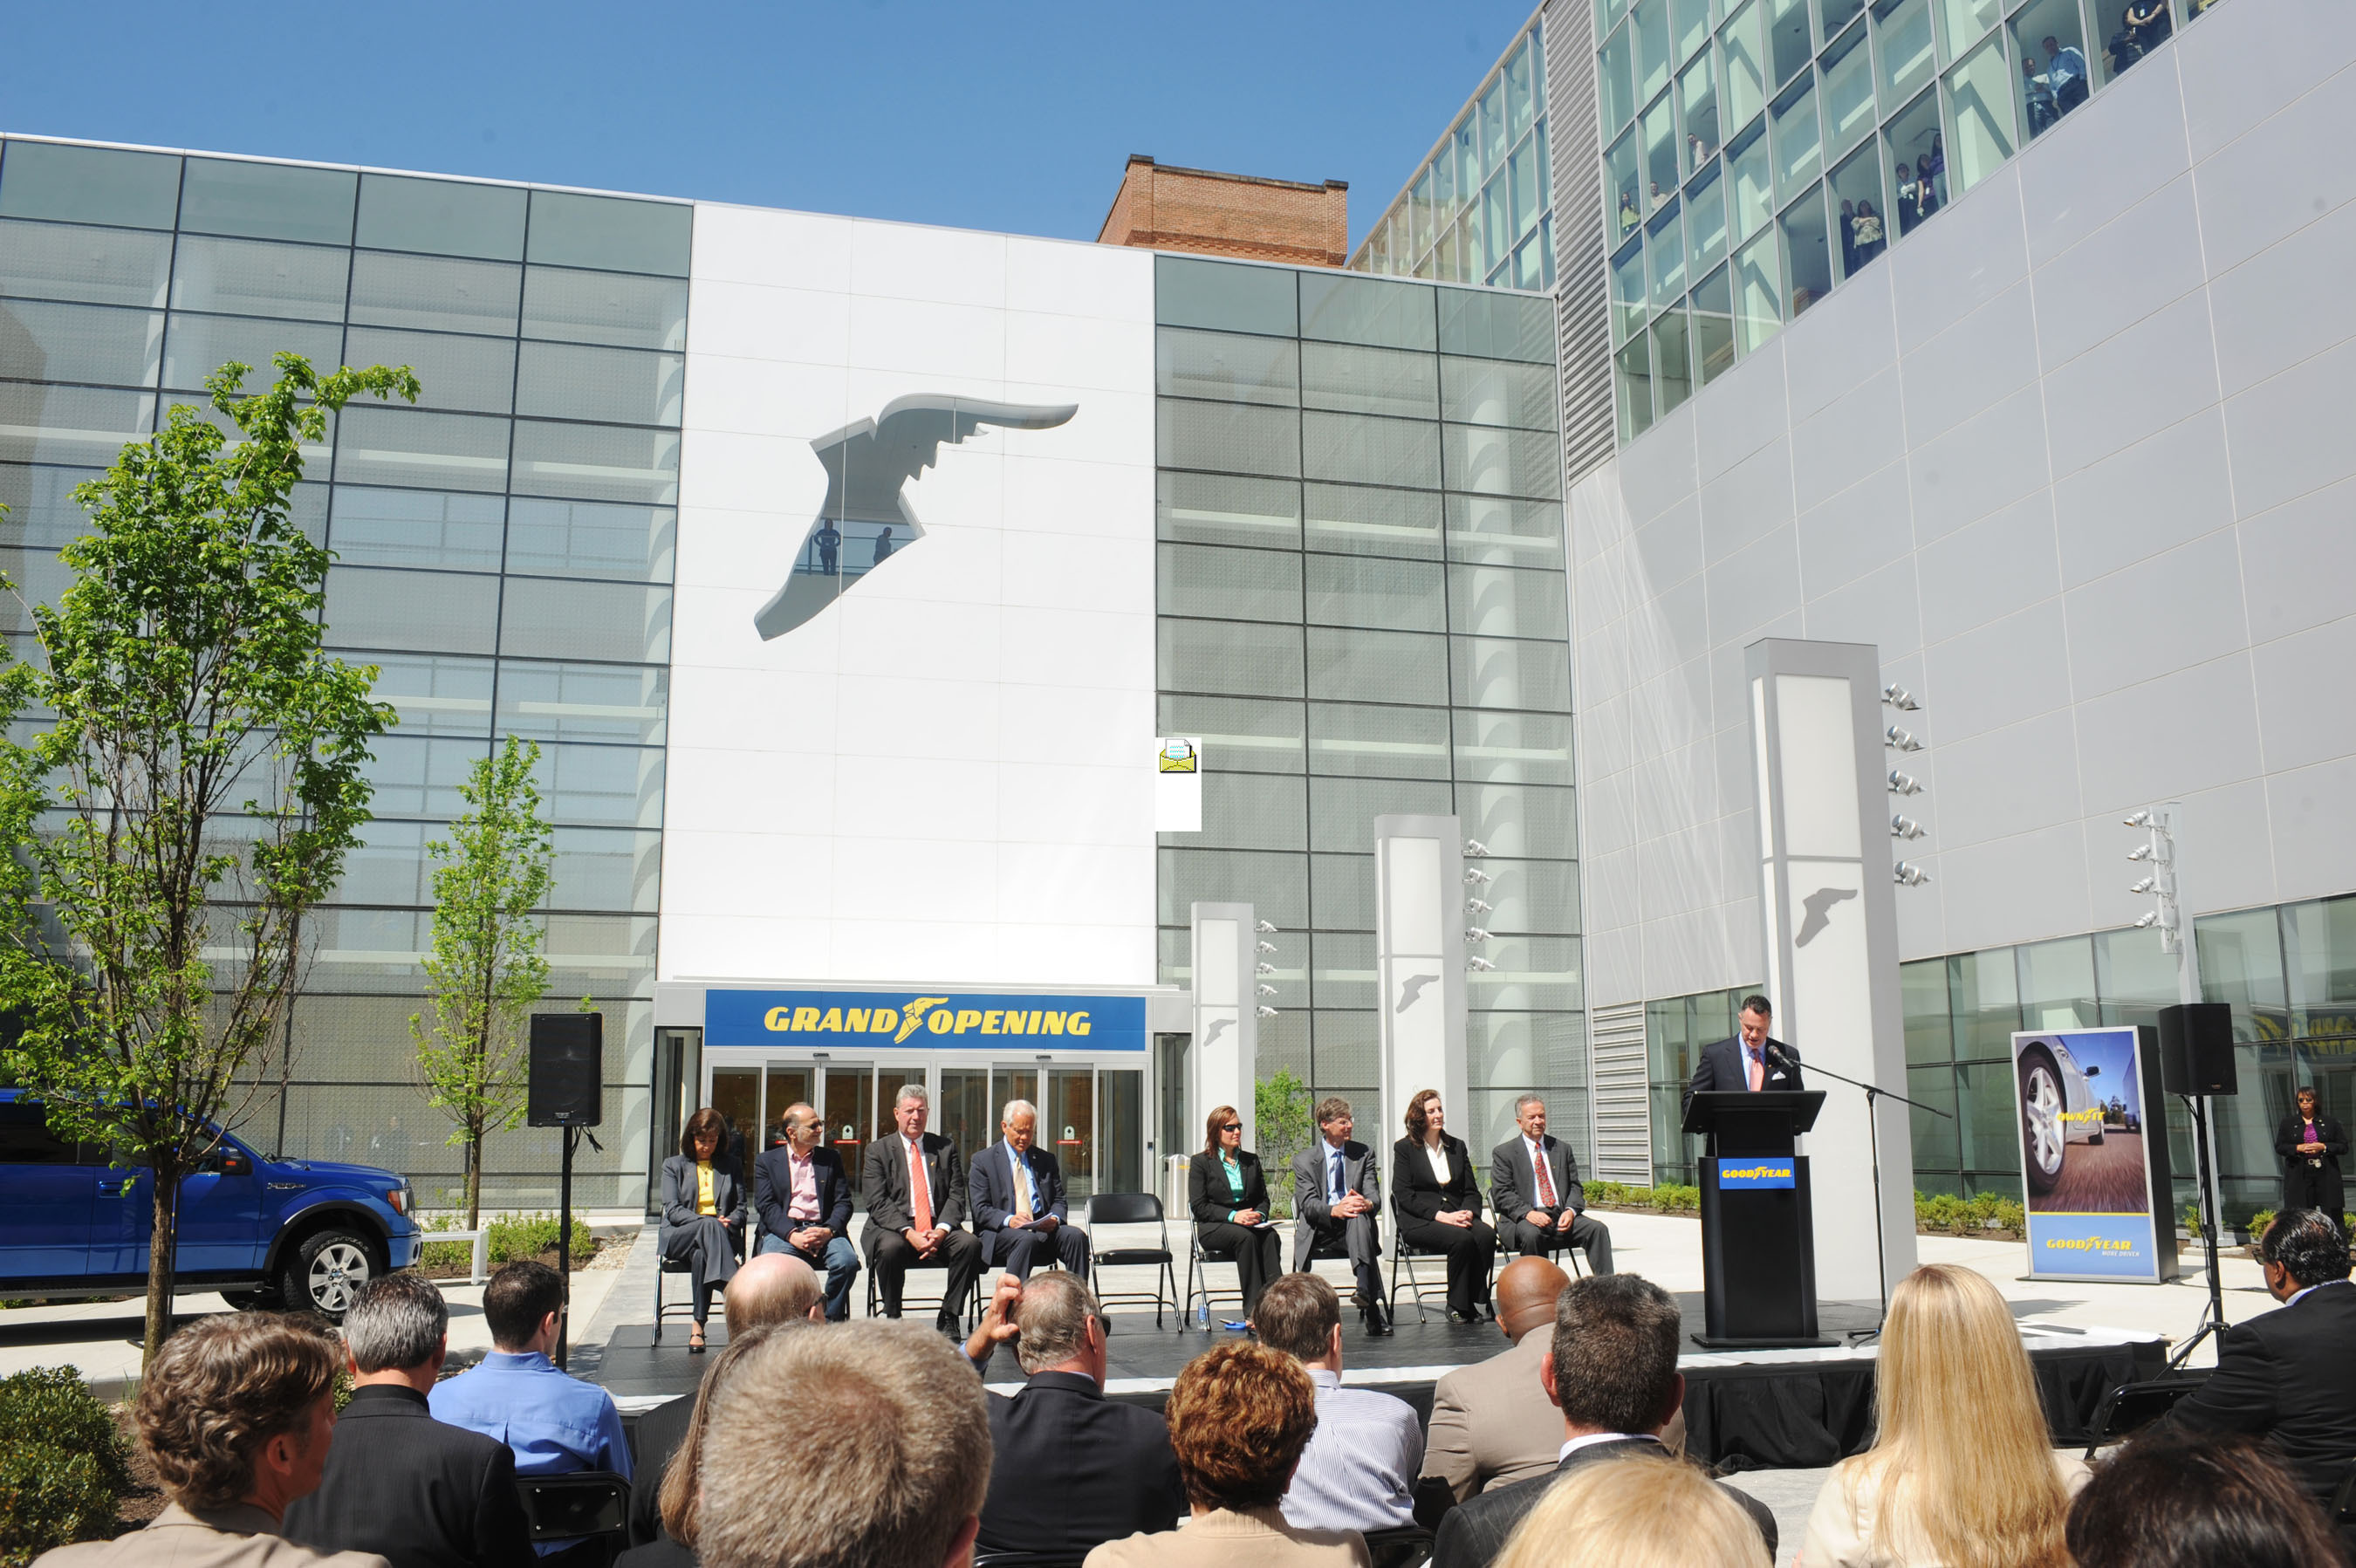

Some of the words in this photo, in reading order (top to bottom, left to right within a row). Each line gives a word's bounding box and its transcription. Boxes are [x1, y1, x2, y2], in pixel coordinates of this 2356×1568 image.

[764, 1006, 899, 1033] GRAND
[928, 1009, 1092, 1036] OPENING
[1722, 1167, 1791, 1179] GOODYEAR
[2046, 1238, 2132, 1250] GOODYEAR
